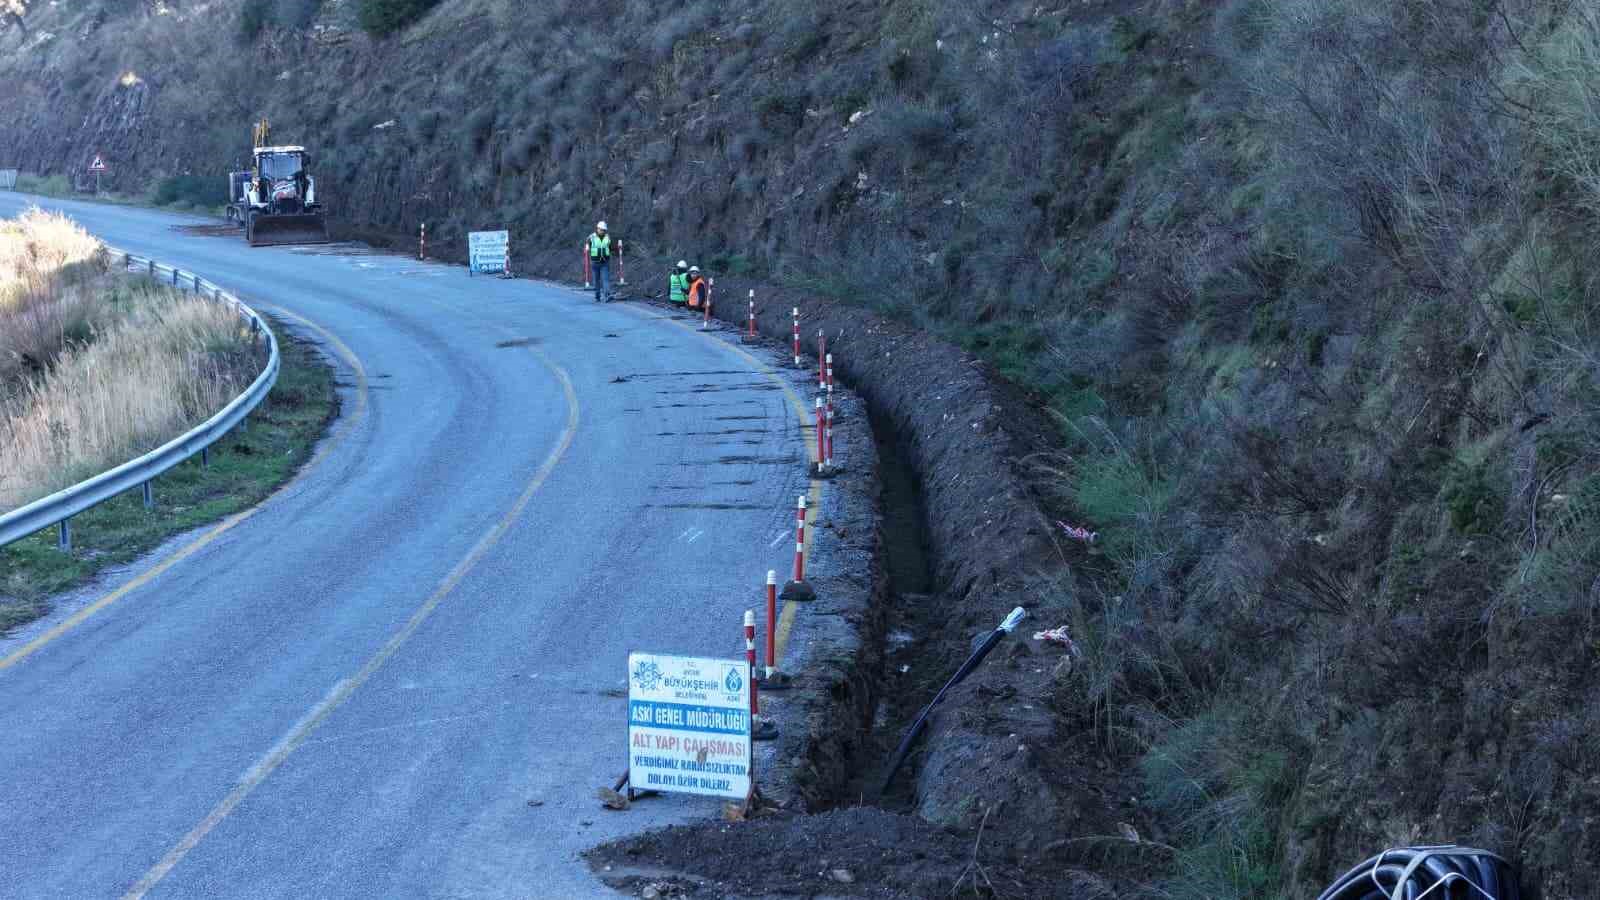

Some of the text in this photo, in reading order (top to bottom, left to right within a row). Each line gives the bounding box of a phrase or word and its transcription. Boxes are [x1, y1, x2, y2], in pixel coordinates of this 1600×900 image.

[664, 676, 719, 690] BÜYÜKŞEHİR
[632, 703, 746, 731] ASKİ GENEL MÜDÜRLÜĞÜ
[633, 733, 746, 757] ALT YAPI ÇALIŞMASI
[648, 773, 675, 785] DOLAYI
[677, 774, 698, 788] ÖZÜR
